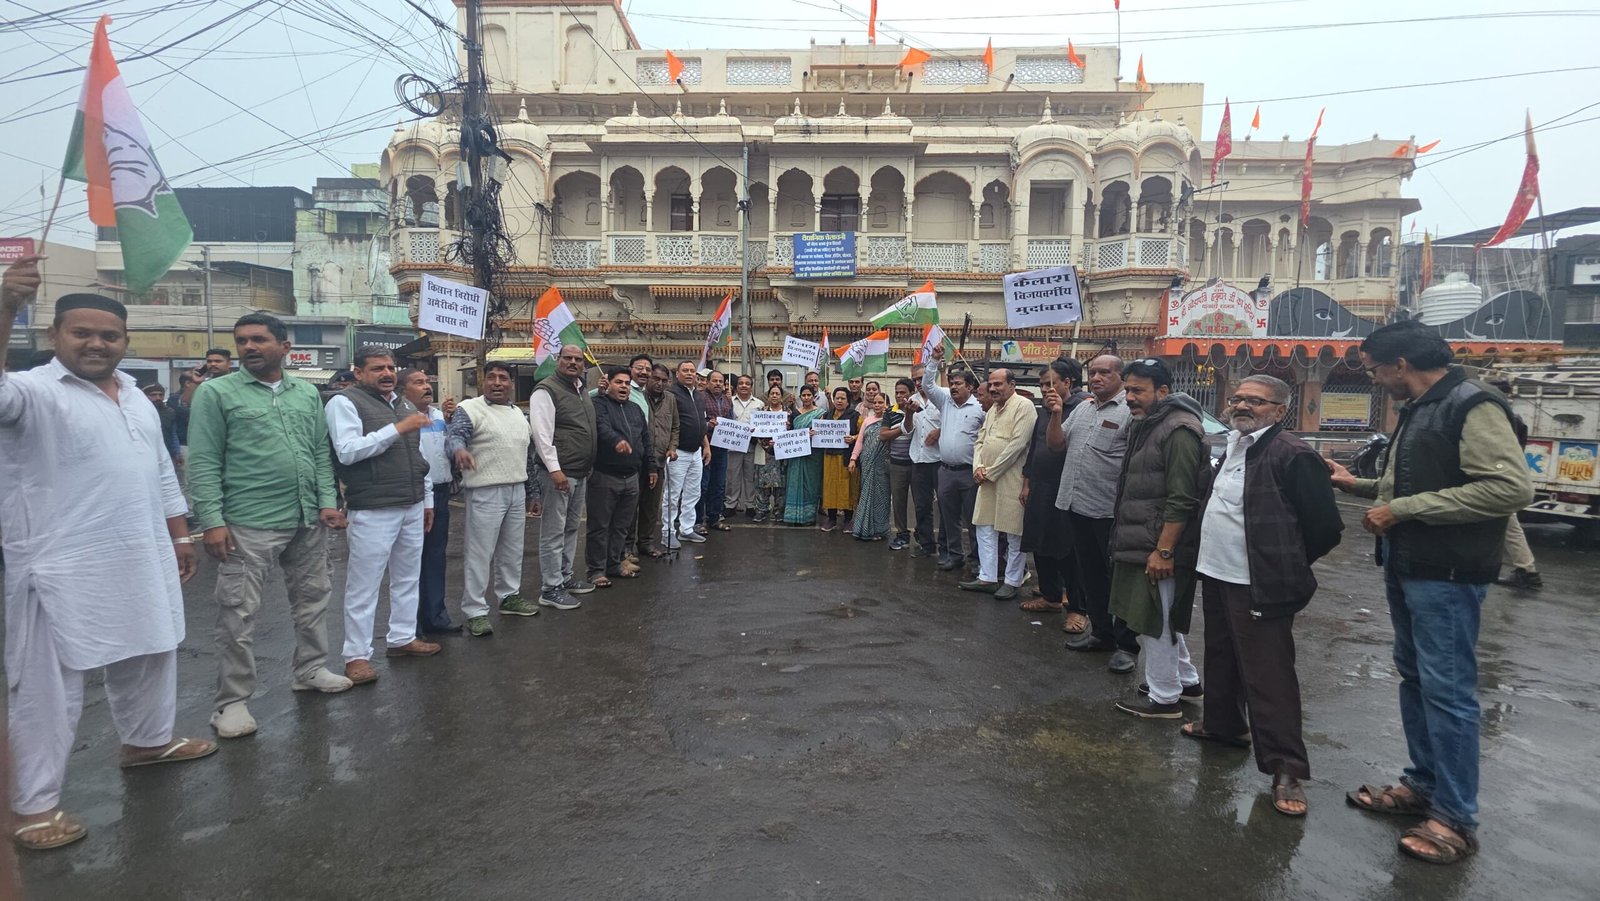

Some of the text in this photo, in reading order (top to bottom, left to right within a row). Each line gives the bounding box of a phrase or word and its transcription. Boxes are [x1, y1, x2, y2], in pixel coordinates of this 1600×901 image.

[427, 280, 480, 304] किसान विरोधी
[460, 304, 478, 317] नीति
[435, 314, 469, 328] वापस लो
